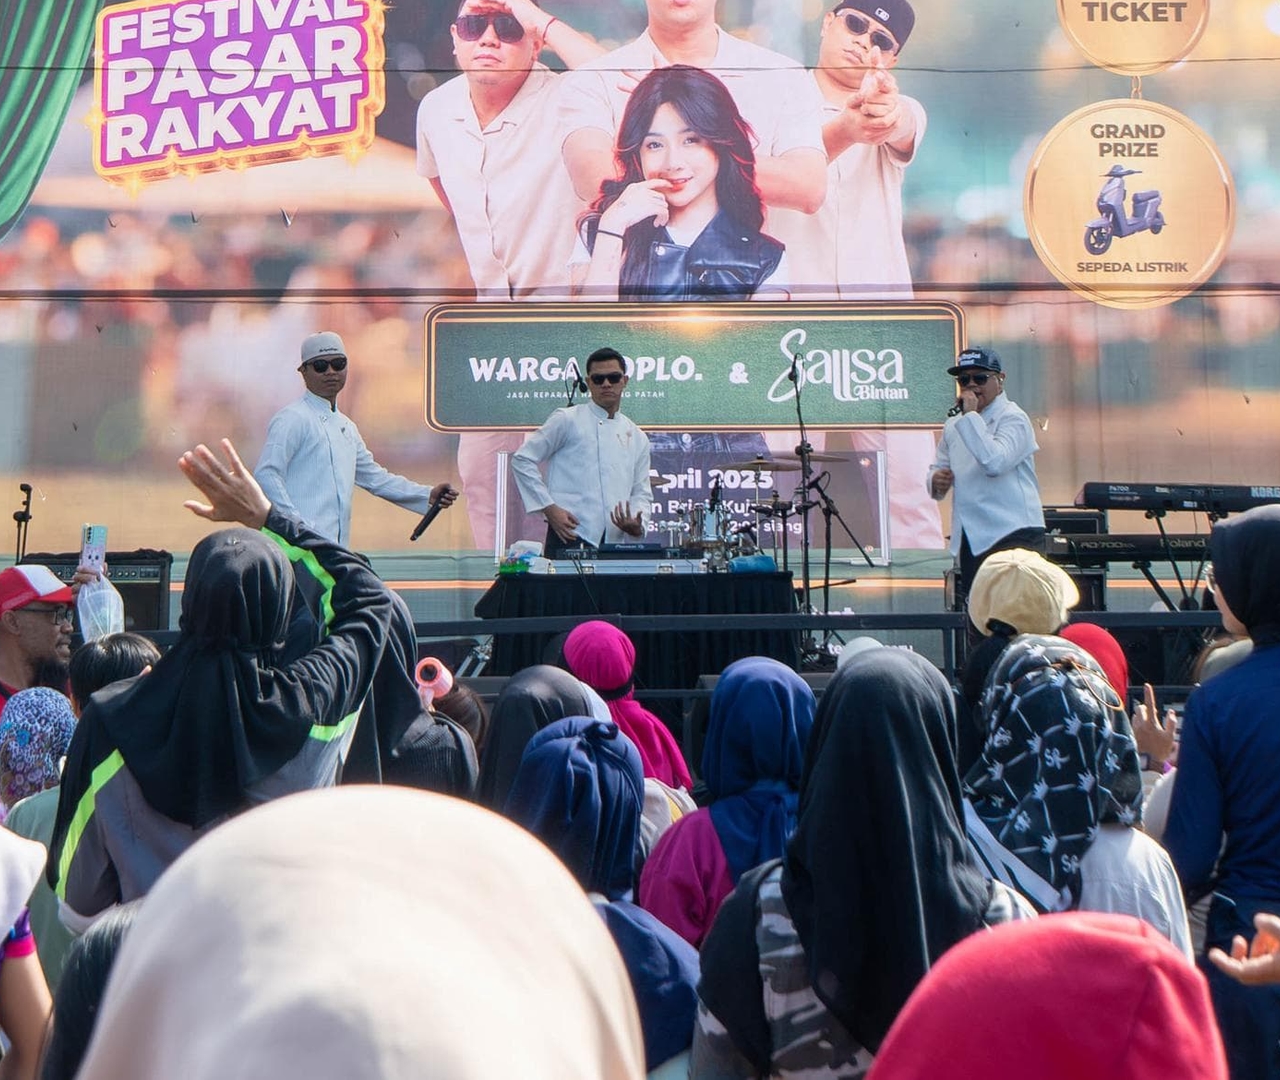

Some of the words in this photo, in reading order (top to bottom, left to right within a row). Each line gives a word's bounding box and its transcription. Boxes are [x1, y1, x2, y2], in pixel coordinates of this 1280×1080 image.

[1081, 1, 1187, 23] TICKET
[107, 24, 363, 111] PASAR
[106, 79, 363, 161] RAKYAT
[1090, 124, 1166, 139] GRAND
[1098, 143, 1159, 157] PRIZE
[1076, 261, 1133, 273] SEPEDA
[1136, 261, 1188, 273] LISTRIK
[469, 356, 579, 382] WARGA
[622, 355, 703, 381] PLO.
[729, 362, 749, 384] &
[506, 391, 530, 399] JASA
[634, 391, 665, 399] PATAH
[854, 384, 909, 401] Bintan
[708, 469, 774, 489] 2025
